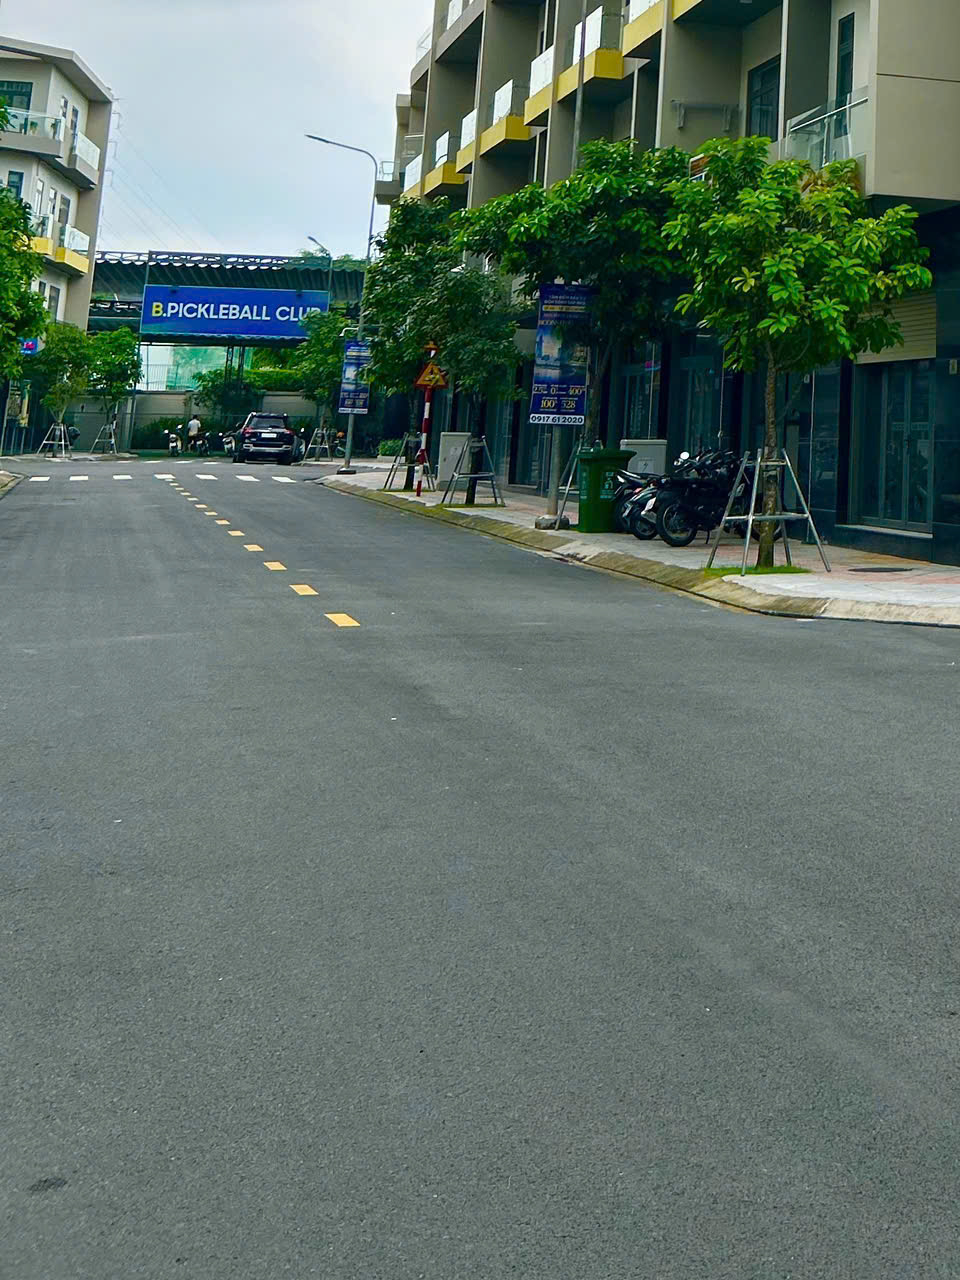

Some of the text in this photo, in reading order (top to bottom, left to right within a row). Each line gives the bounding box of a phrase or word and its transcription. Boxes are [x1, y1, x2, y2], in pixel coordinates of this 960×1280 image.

[152, 301, 321, 322] B.PICKLEBALL CLU
[561, 416, 583, 424] 2020
